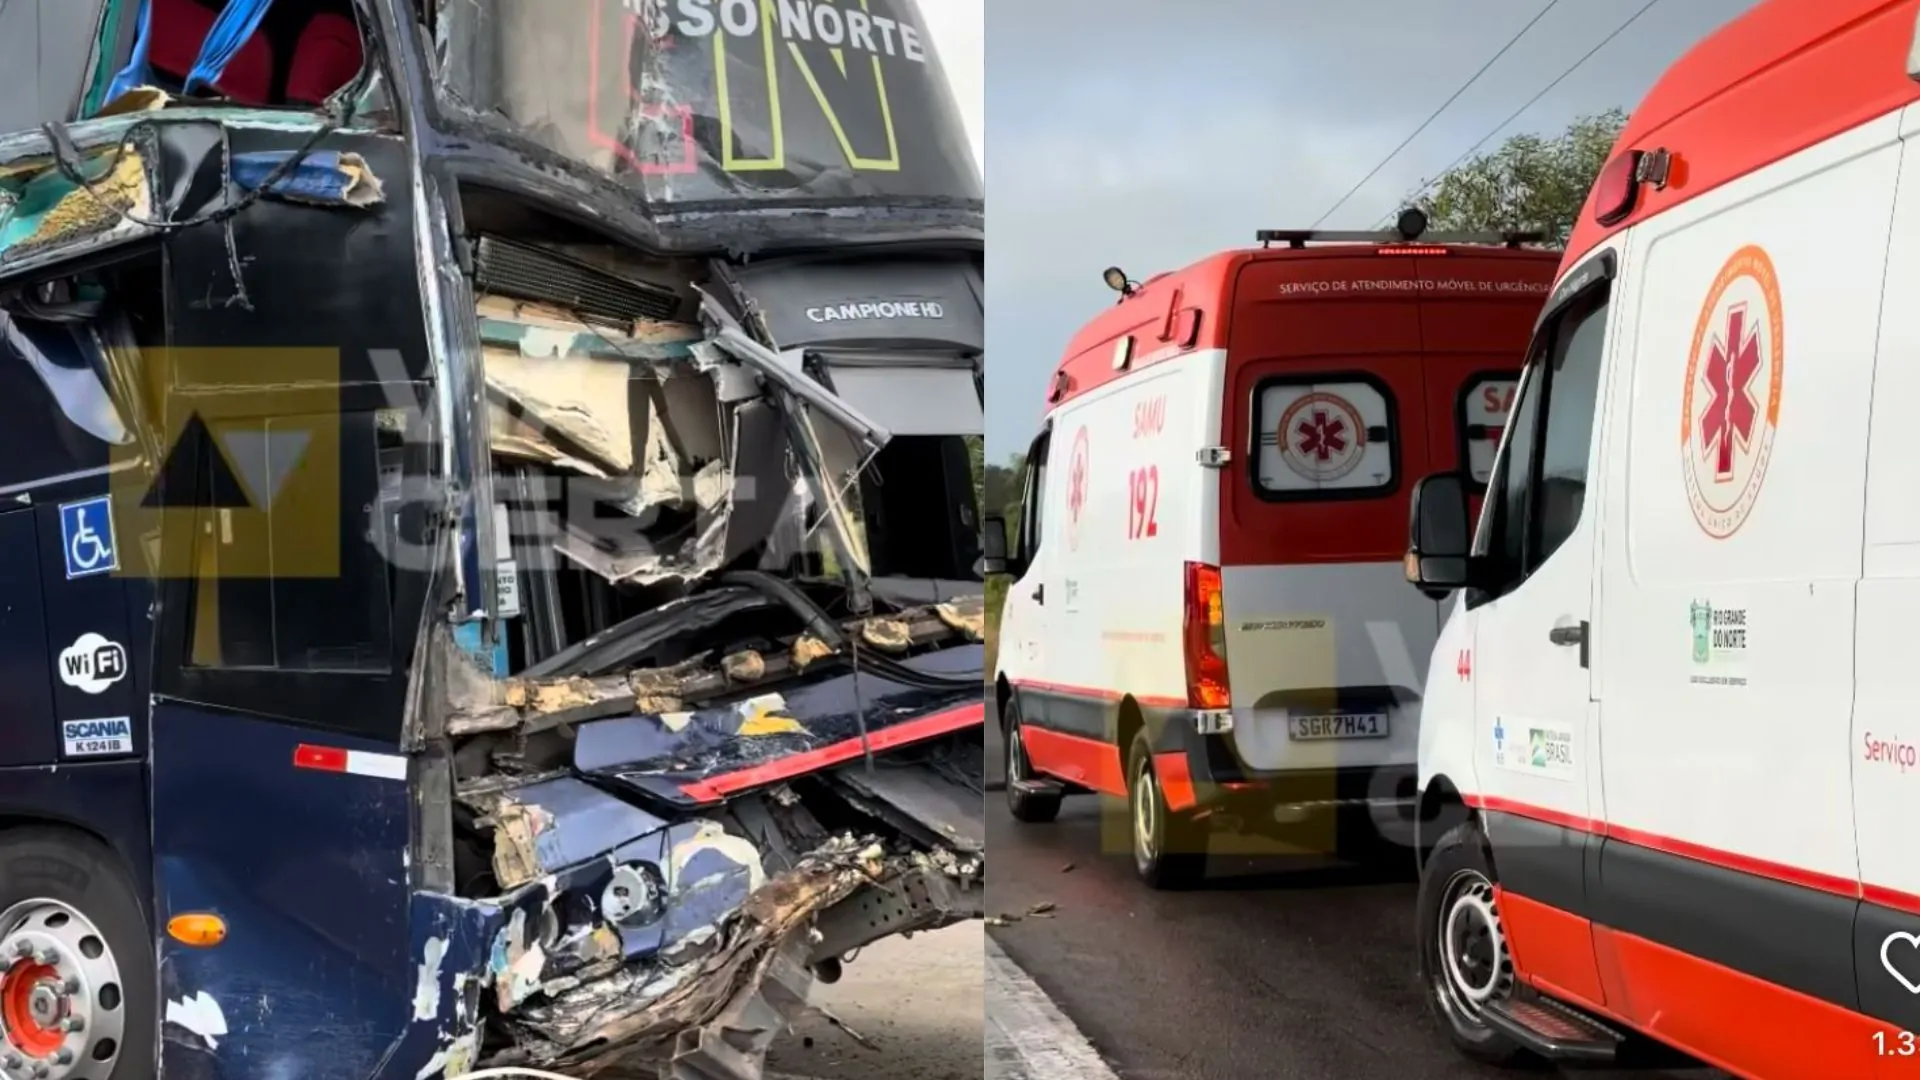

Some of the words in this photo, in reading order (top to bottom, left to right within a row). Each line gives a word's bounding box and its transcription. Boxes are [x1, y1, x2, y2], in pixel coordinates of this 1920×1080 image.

[778, 0, 926, 63] NORTE
[1279, 280, 1330, 294] SERVIÇO
[1332, 281, 1347, 291] DE
[1351, 279, 1434, 291] ATENDIMENTO
[1437, 278, 1475, 292] MÓVEL
[1479, 281, 1493, 292] DE
[1128, 464, 1158, 540] 192
[1457, 649, 1471, 682] 44
[65, 721, 129, 739] SCANIA
[1298, 715, 1379, 736] SGR7H41
[1545, 741, 1573, 765] BRASIL
[1864, 731, 1916, 774] Serviço
